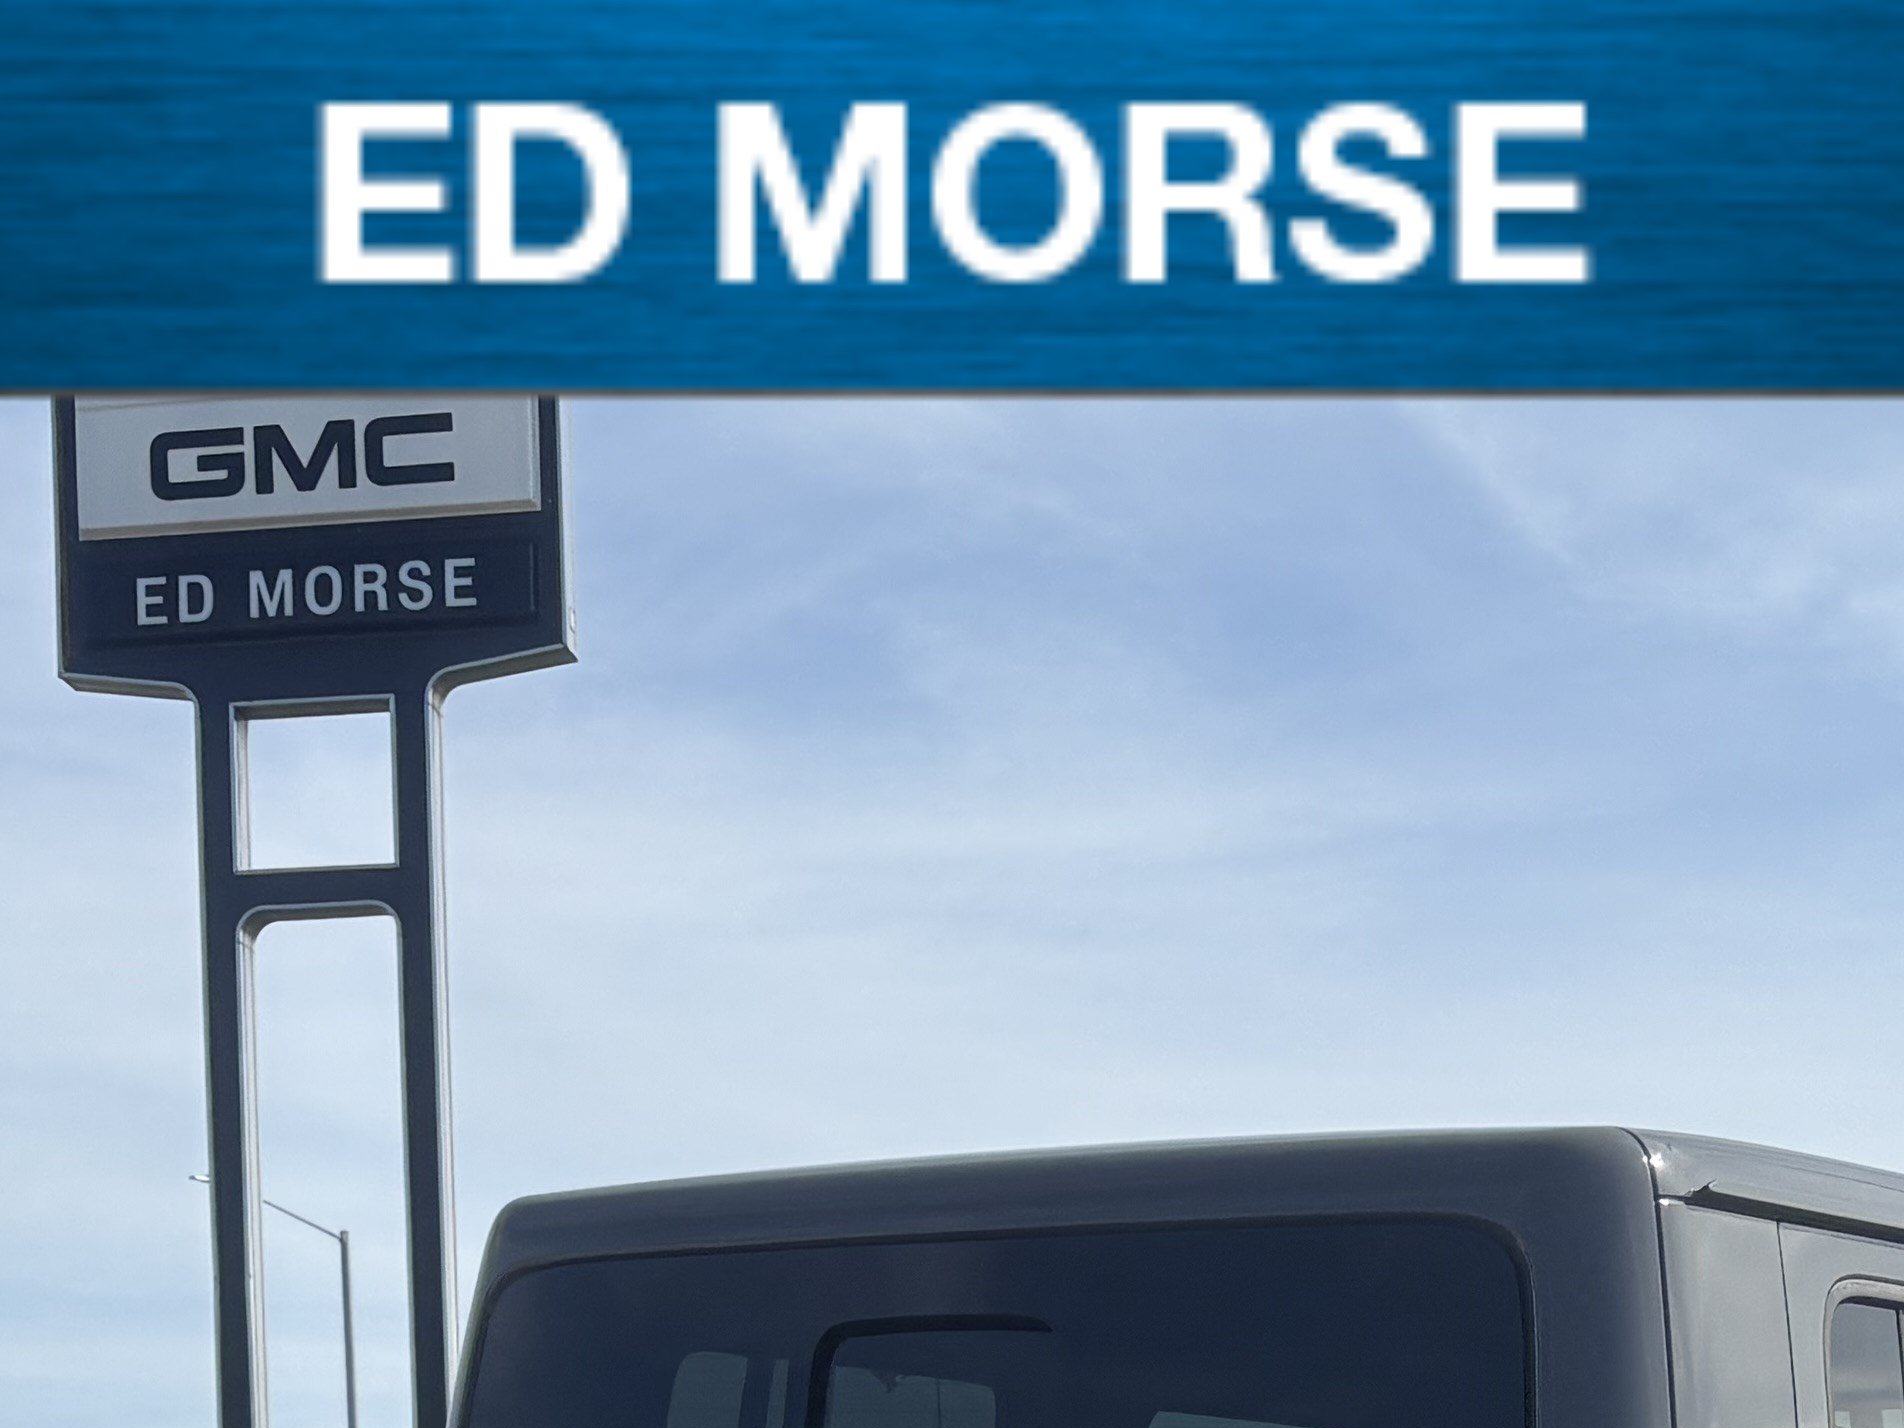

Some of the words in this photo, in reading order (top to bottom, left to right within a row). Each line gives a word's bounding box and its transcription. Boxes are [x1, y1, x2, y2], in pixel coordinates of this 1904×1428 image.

[149, 411, 455, 500] GMC
[135, 573, 215, 626] ED
[248, 556, 478, 618] MORSE
